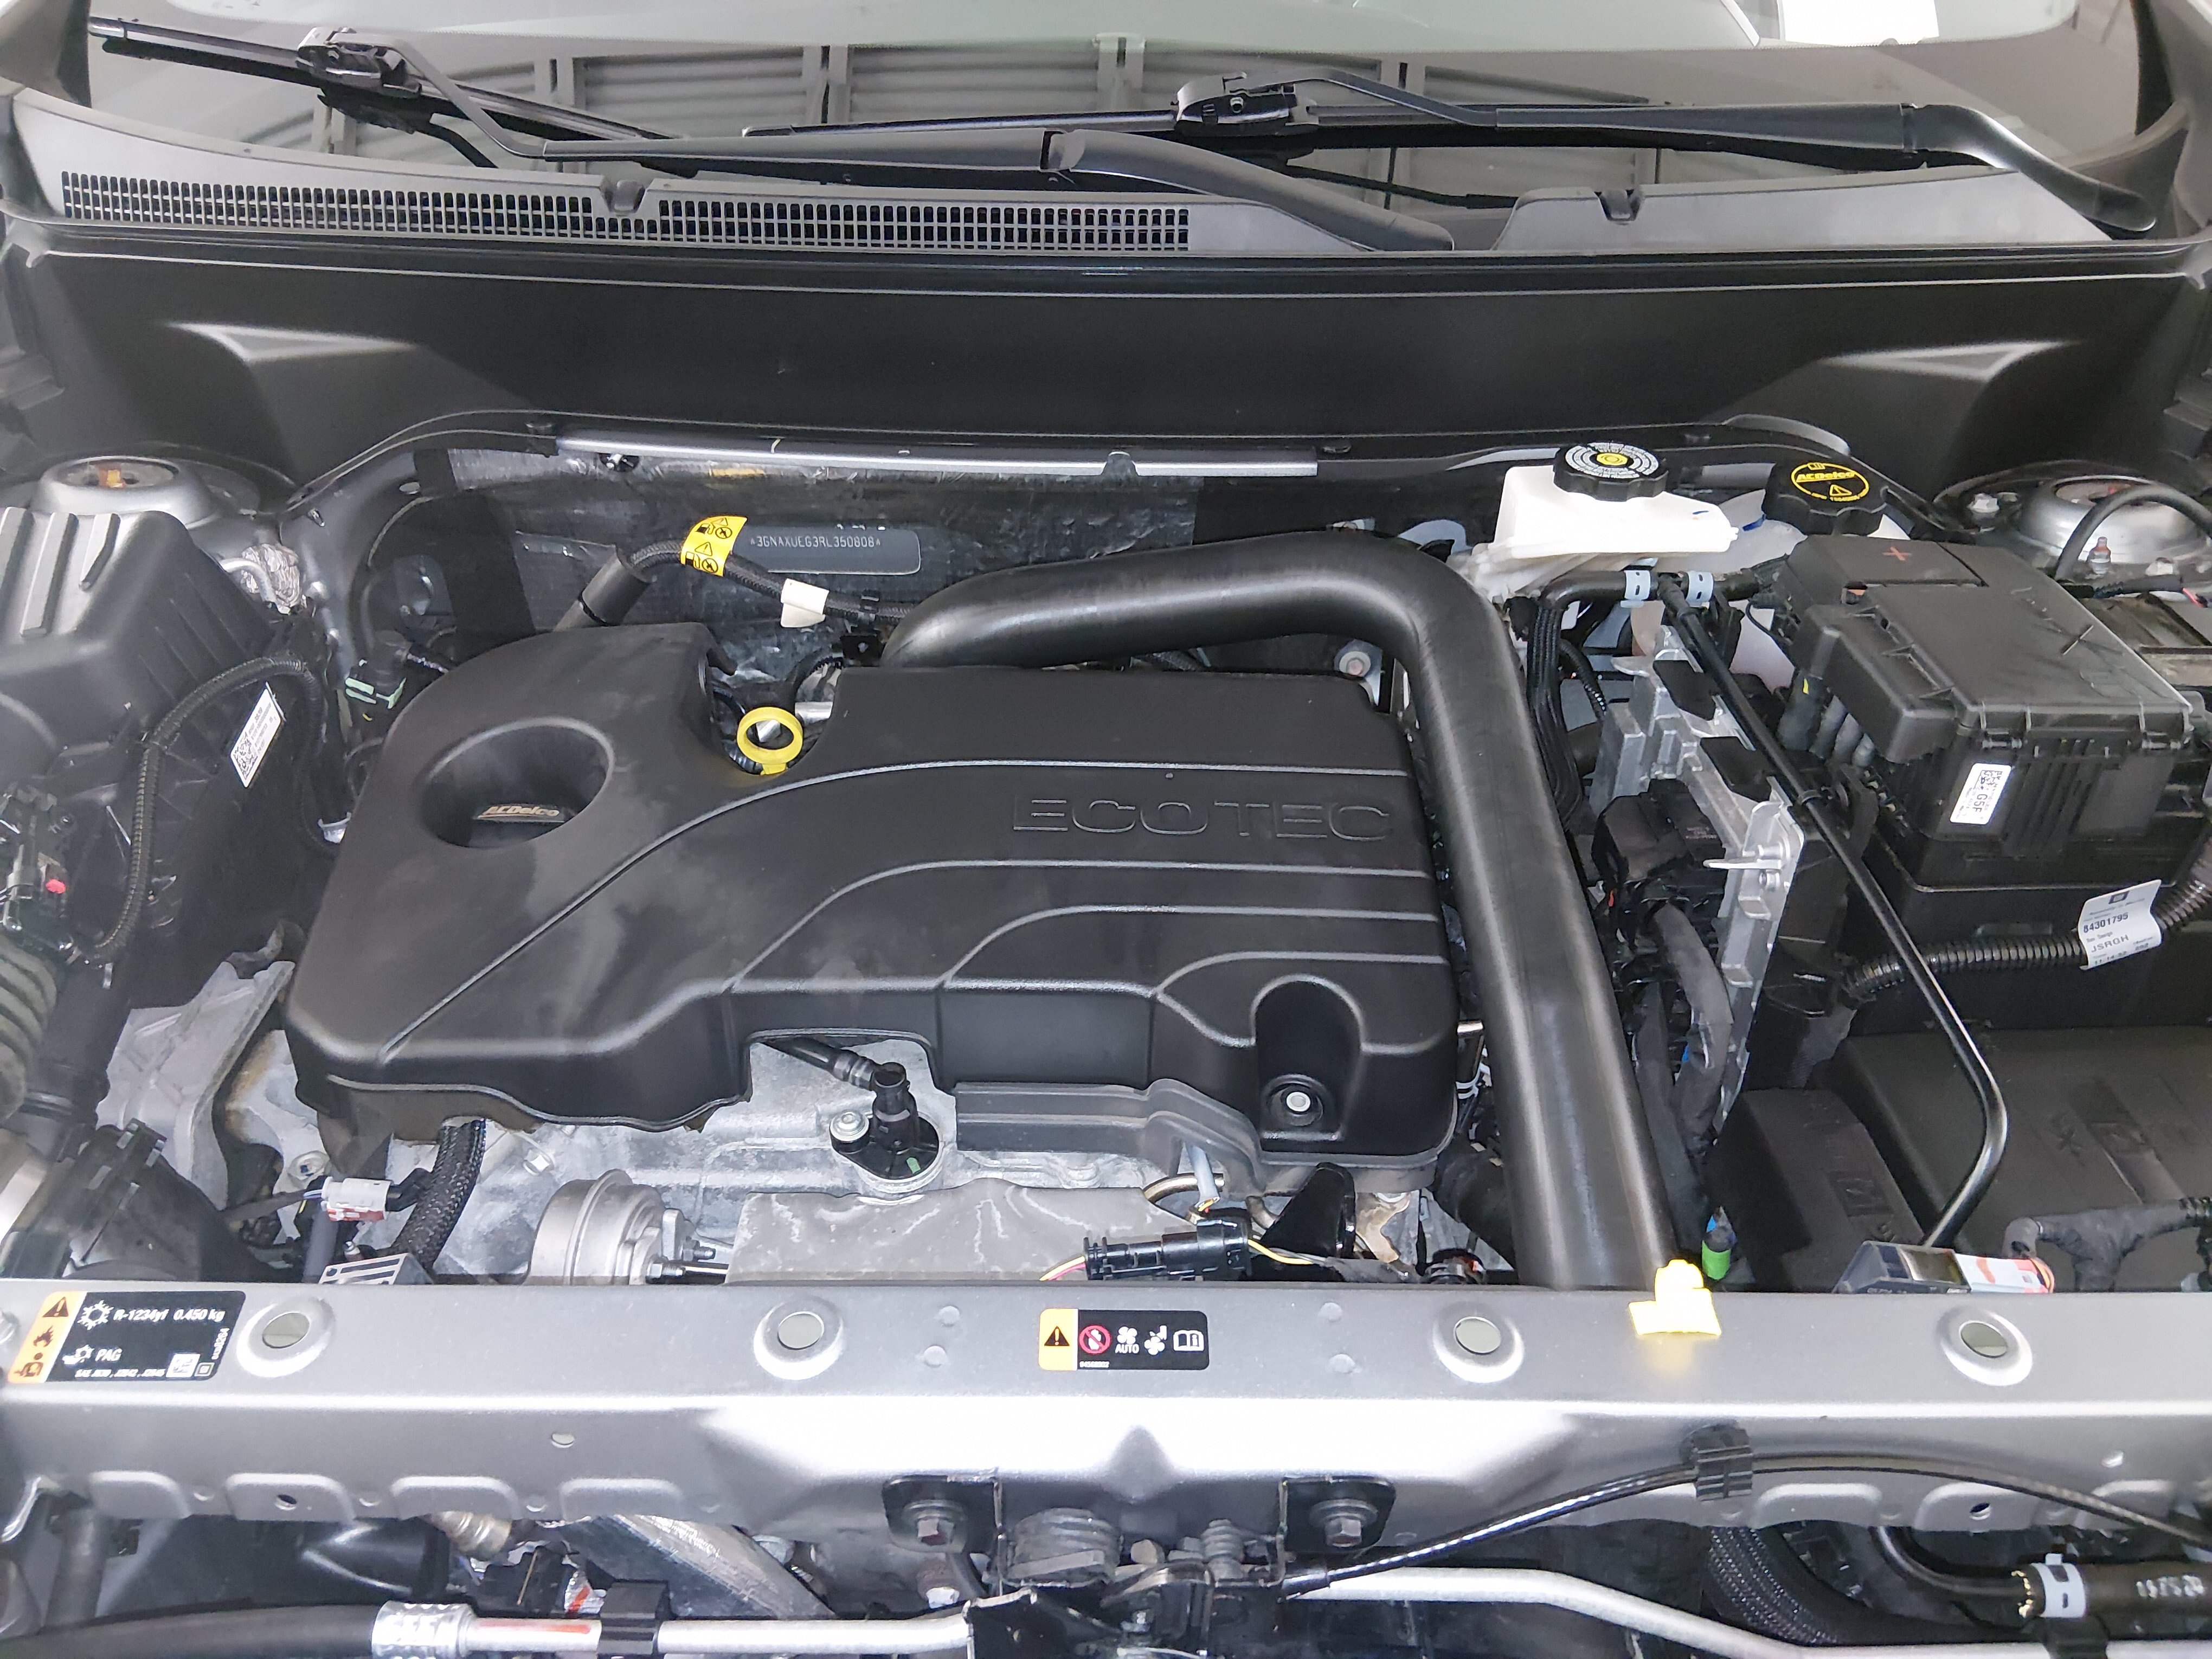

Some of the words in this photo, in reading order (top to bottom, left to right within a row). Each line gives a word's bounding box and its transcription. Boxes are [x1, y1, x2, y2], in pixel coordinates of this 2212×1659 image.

[1972, 794, 1988, 813] G5F
[482, 806, 560, 816] ACDelco
[1013, 798, 1391, 842] ECOTEC
[2083, 911, 2129, 933] 84301795
[173, 1308, 208, 1321] 0.450
[208, 1308, 226, 1322] kg
[95, 1348, 123, 1361] PAG
[1115, 1344, 1139, 1353] AUTO
